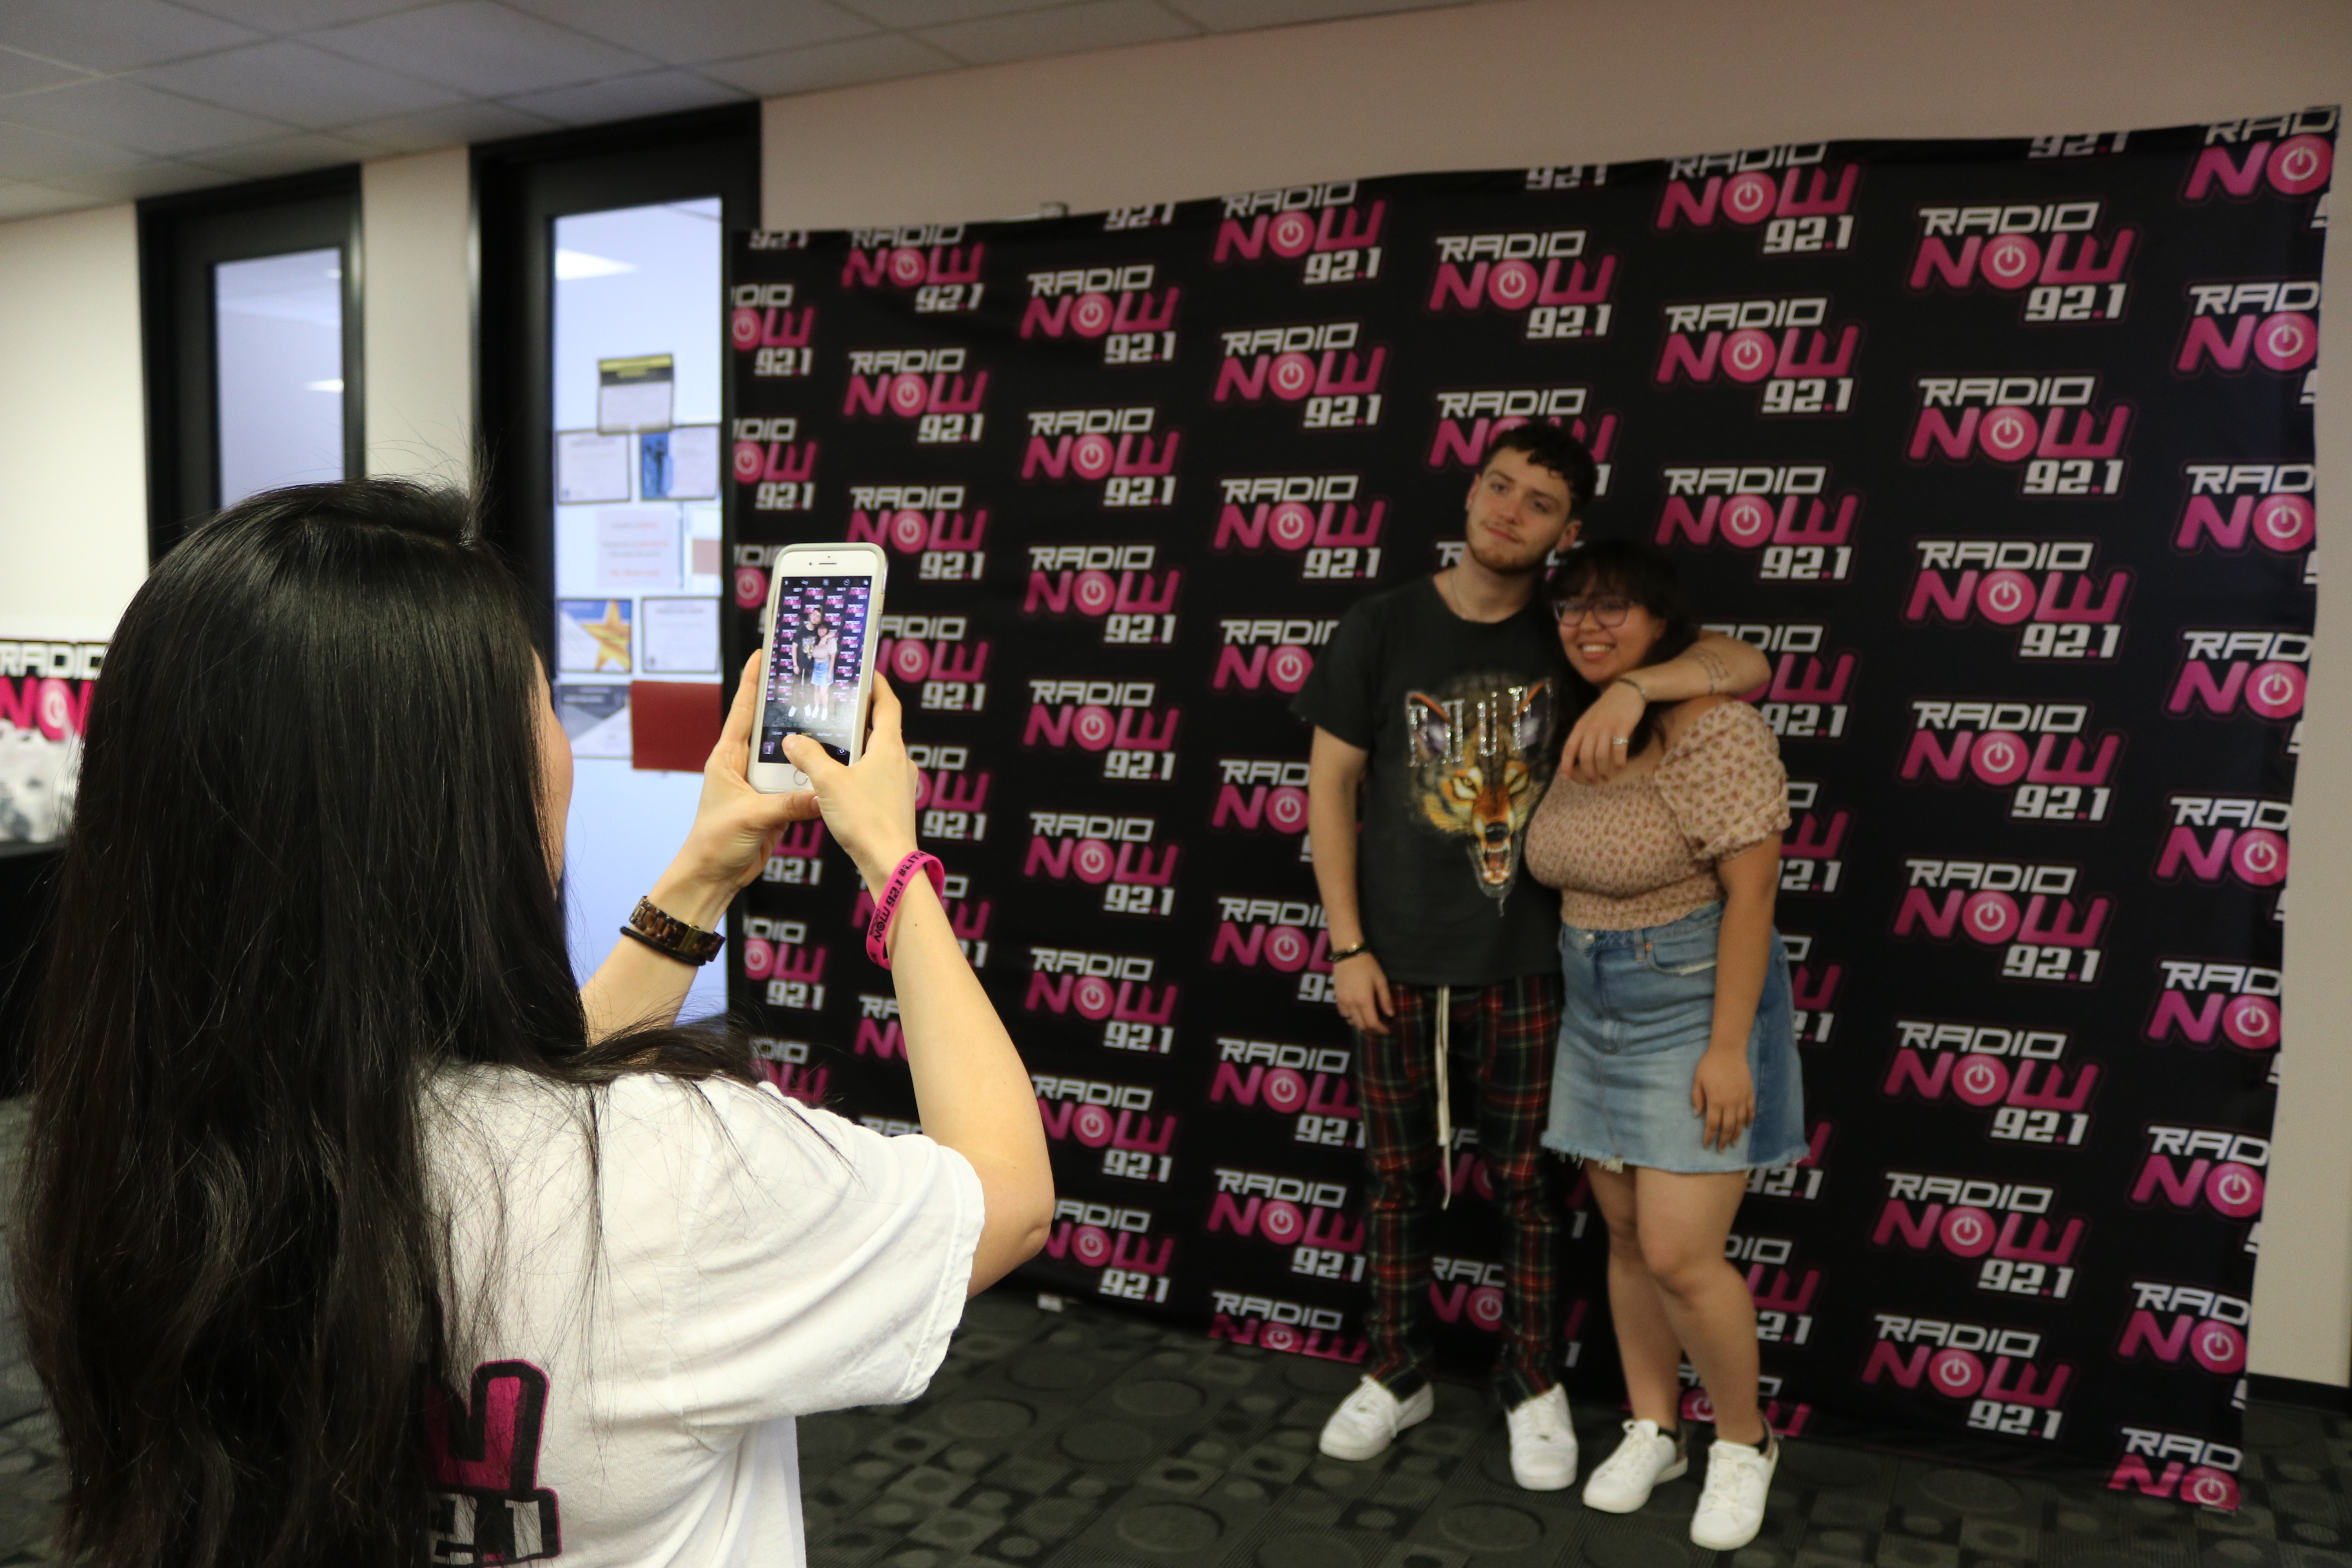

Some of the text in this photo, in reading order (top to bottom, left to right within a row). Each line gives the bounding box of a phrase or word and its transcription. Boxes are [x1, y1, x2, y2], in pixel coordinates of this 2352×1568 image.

[1221, 181, 1358, 219] RADIO
[1657, 164, 1858, 229] NOW
[1214, 200, 1386, 263] NOW
[1764, 216, 1853, 252] 92.1
[1921, 203, 2098, 235] RADIO
[1438, 232, 1585, 261] RADIO
[1911, 230, 2133, 289] NOW
[841, 241, 984, 287] NOW
[1029, 266, 1153, 295] RADIO
[1305, 248, 1380, 283] 92.1
[917, 284, 982, 310] 92.1
[1430, 256, 1614, 309] NOW
[1022, 289, 1178, 337] NOW
[1666, 299, 1826, 332] RADIO
[2026, 285, 2125, 320] 92.1
[1528, 305, 1610, 338] 92.1
[1106, 332, 1174, 362] 92.1
[1223, 323, 1357, 356] RADIO
[1658, 327, 1857, 382] NOW
[756, 348, 811, 375] 92.1
[850, 349, 965, 373] RADIO
[1215, 348, 1385, 401] NOW
[844, 372, 987, 417] NOW
[1438, 389, 1586, 417] RADIO
[1763, 379, 1853, 412] 92.1
[1920, 377, 2094, 406] RADIO
[1029, 408, 1153, 435] RADIO
[1305, 395, 1380, 427] 92.1
[918, 414, 983, 442] 92.1
[1910, 405, 2128, 461] NOW
[1022, 432, 1179, 479] NOW
[1105, 477, 1175, 505] 92.1
[1221, 476, 1357, 503] RADIO
[1665, 468, 1825, 494] RADIO
[2024, 461, 2123, 493] 92.1
[757, 483, 813, 509] 92.1
[851, 487, 964, 509] RADIO
[847, 510, 986, 553] NOW
[1215, 501, 1384, 550] NOW
[1657, 494, 1856, 547] NOW
[920, 552, 984, 579] 92.1
[1030, 546, 1154, 570] RADIO
[1304, 548, 1380, 577] 92.1
[1761, 547, 1851, 578] 92.1
[1918, 542, 2092, 570] RADIO
[1024, 570, 1179, 615] NOW
[1907, 569, 2127, 624] NOW
[880, 615, 967, 641] ADIO
[1105, 615, 1175, 642] 92.1
[2021, 624, 2120, 657] 92.1
[1214, 644, 1314, 693] NO
[922, 682, 985, 710] 92.1
[1030, 681, 1154, 706] RADIO
[1025, 704, 1178, 751] NOW
[1760, 703, 1848, 737] 92.1
[1914, 702, 2086, 732] RADIO
[908, 746, 968, 770] DIO
[1105, 751, 1174, 779] 92.1
[1219, 759, 1310, 786] RAD
[1902, 730, 2118, 784] NOW
[1212, 784, 1309, 834] NO
[2013, 786, 2109, 820] 92.1
[924, 811, 985, 840] 92.1
[1031, 813, 1153, 841] RADIO
[764, 857, 821, 884] 92.1
[1025, 837, 1177, 885] NOW
[1779, 859, 1842, 892] 2.1
[1907, 861, 2076, 893] RADIO
[1105, 885, 1173, 915] 92.1
[1896, 889, 2107, 946] NOW
[1032, 949, 1152, 980] RADIO
[2004, 946, 2100, 981] 92.1
[768, 980, 823, 1009] 92.1
[1026, 972, 1176, 1024] NOW
[1105, 1022, 1172, 1053] 92.1
[1898, 1022, 2066, 1059] RADIO
[1218, 1039, 1348, 1072] RADIO
[1031, 1075, 1153, 1111] RADIO
[1886, 1050, 2097, 1110] NOW
[1294, 1113, 1367, 1149] 92.1
[1992, 1108, 2088, 1144] 92.1
[1104, 1150, 1171, 1181] 92.1
[1216, 1170, 1345, 1207] RADIO
[1888, 1174, 2052, 1212] RADIO
[1054, 1199, 1152, 1233] ADIO
[1875, 1201, 2081, 1263] NOW
[1291, 1246, 1367, 1283] 92.1
[1979, 1260, 2073, 1297] 92.1
[1100, 1269, 1168, 1301] 92.1
[1214, 1292, 1340, 1327] RADIO
[1755, 1311, 1813, 1345] 2.1
[1877, 1316, 2039, 1357] RADIO
[1862, 1342, 2069, 1406] NOW
[1969, 1401, 2061, 1438] 92.1
